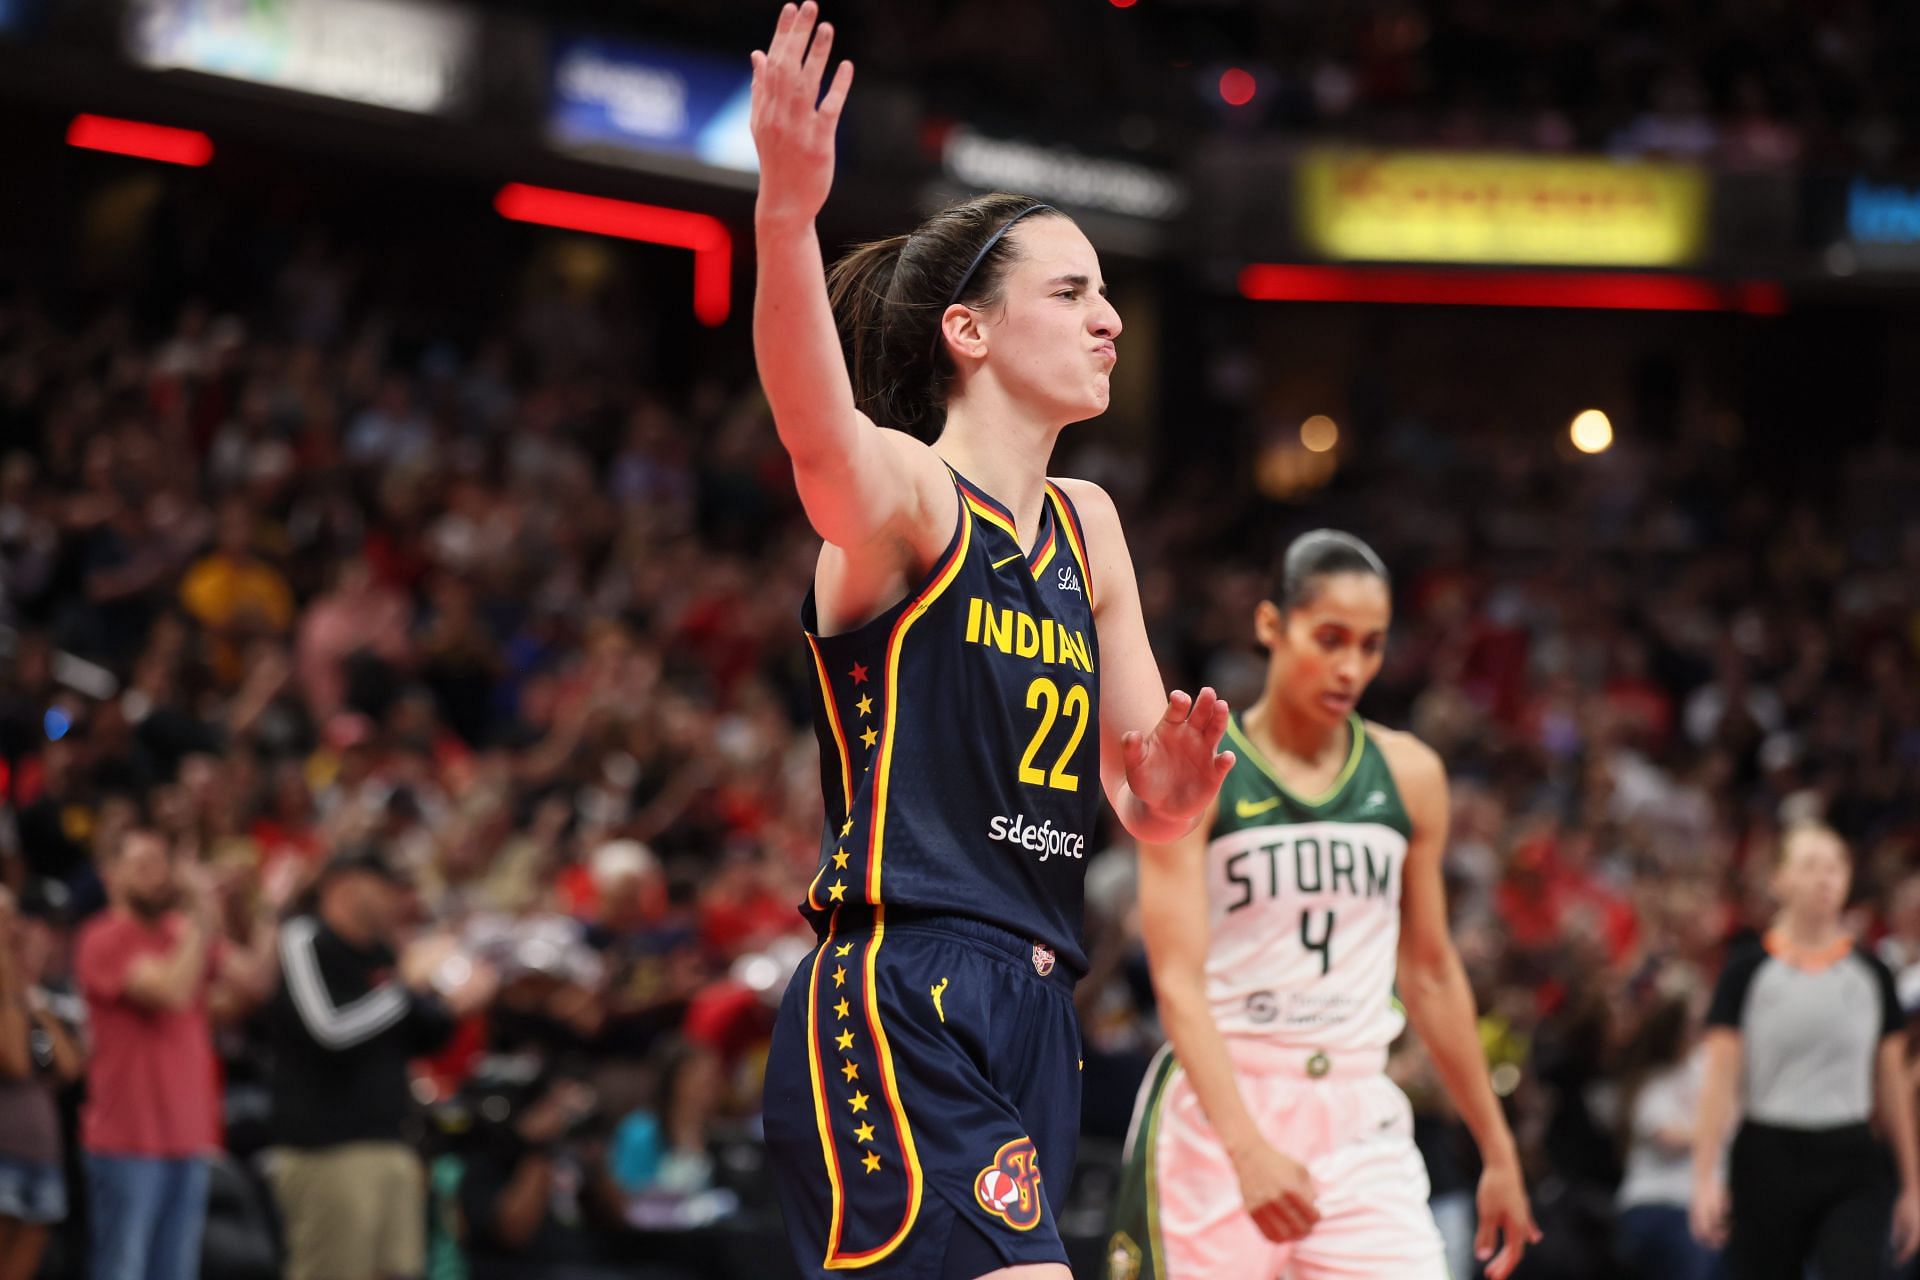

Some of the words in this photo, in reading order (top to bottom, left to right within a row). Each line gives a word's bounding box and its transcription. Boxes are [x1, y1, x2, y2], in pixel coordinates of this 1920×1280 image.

[1057, 566, 1082, 601] Lilly
[965, 597, 1094, 674] INDIAN
[1018, 677, 1090, 792] 22
[1224, 838, 1391, 914] STORM
[1300, 907, 1336, 976] 4
